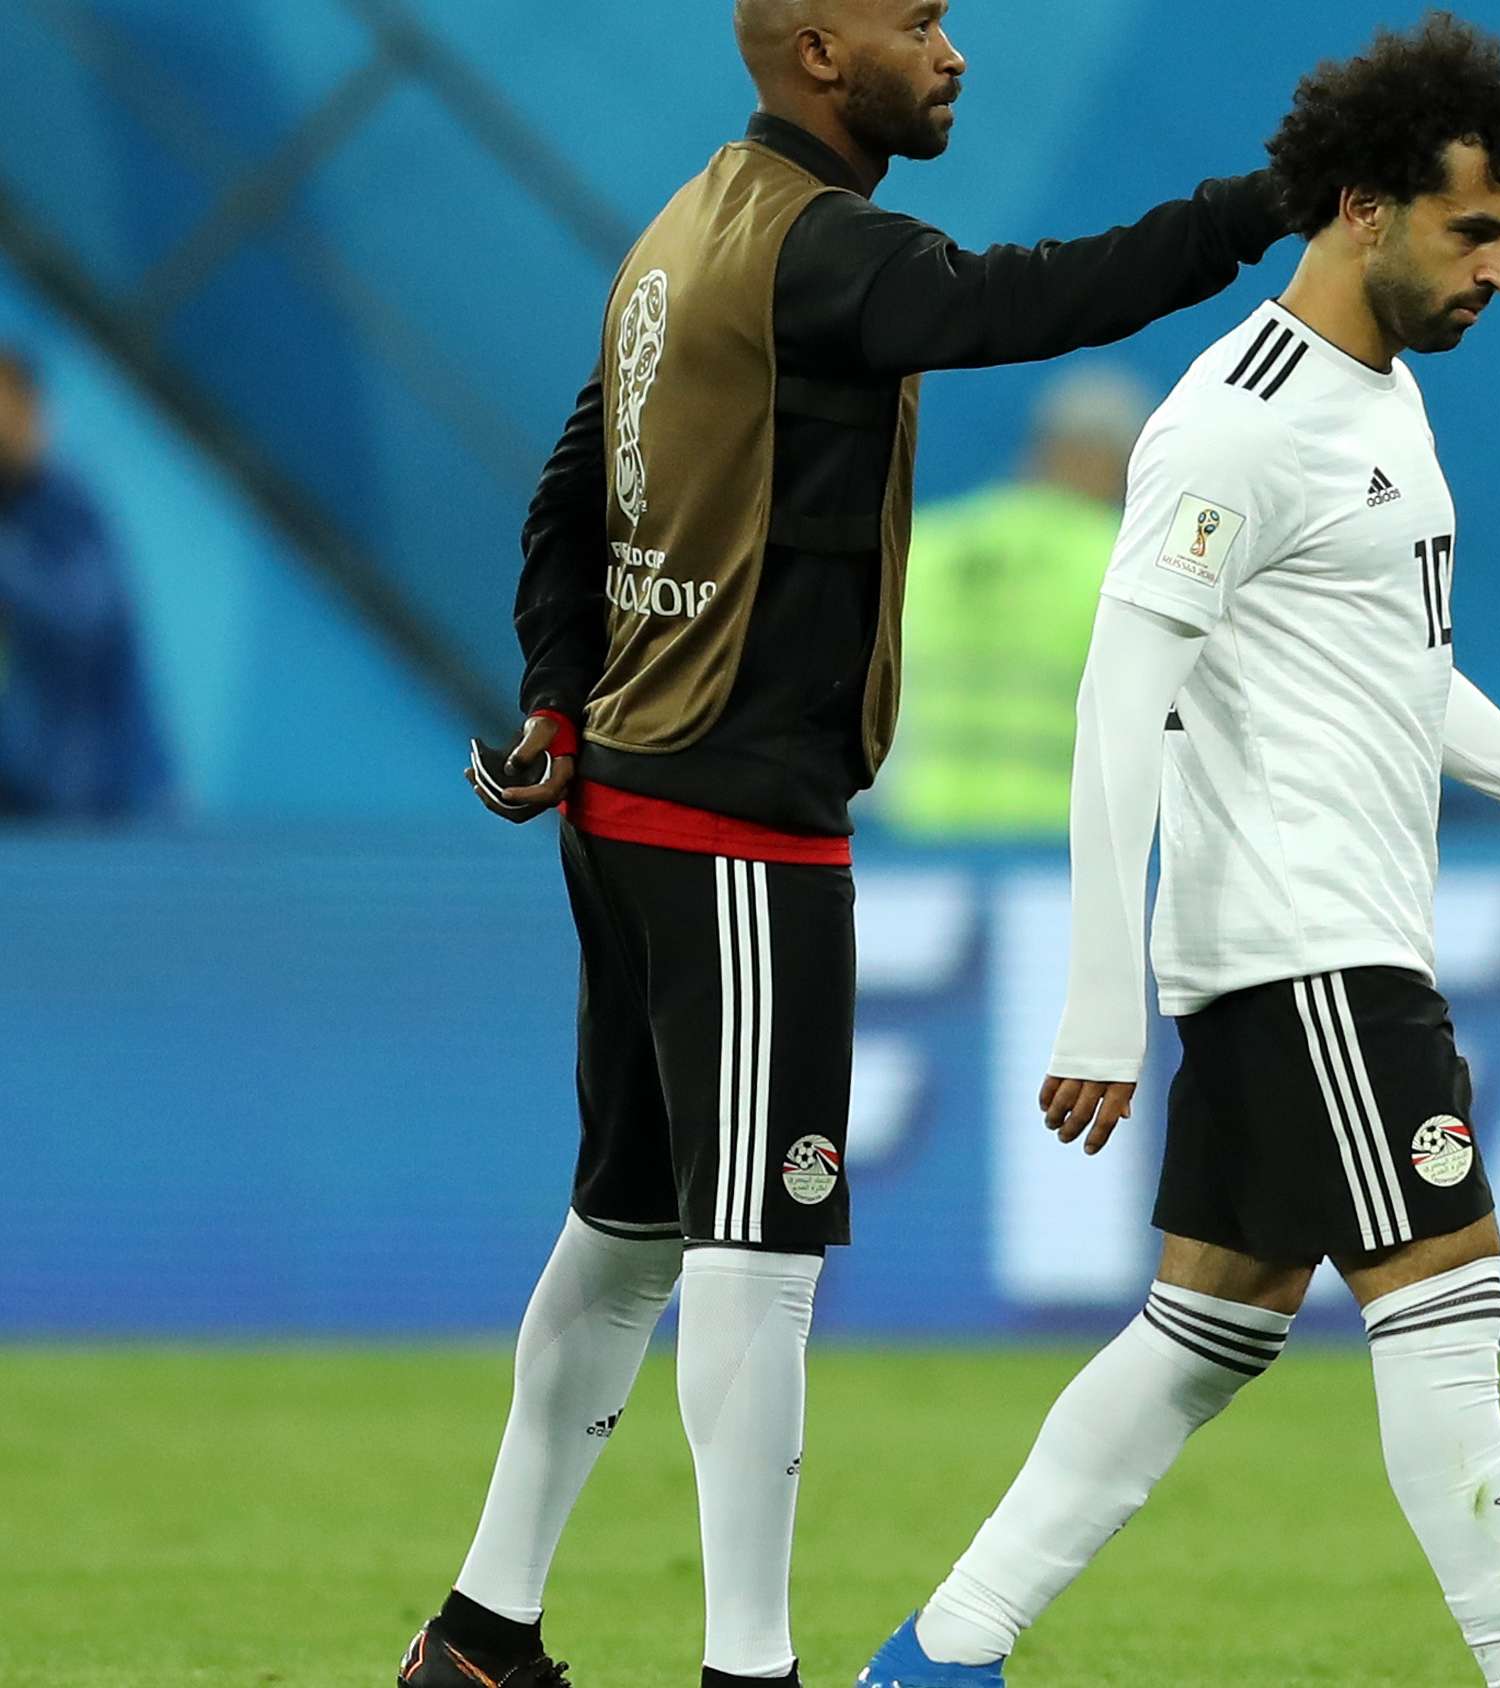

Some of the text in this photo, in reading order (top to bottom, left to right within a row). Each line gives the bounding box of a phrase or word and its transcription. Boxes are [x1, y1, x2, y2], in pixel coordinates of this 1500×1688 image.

[1366, 488, 1401, 507] adidas
[638, 575, 717, 618] 2018
[1414, 534, 1452, 648] 10
